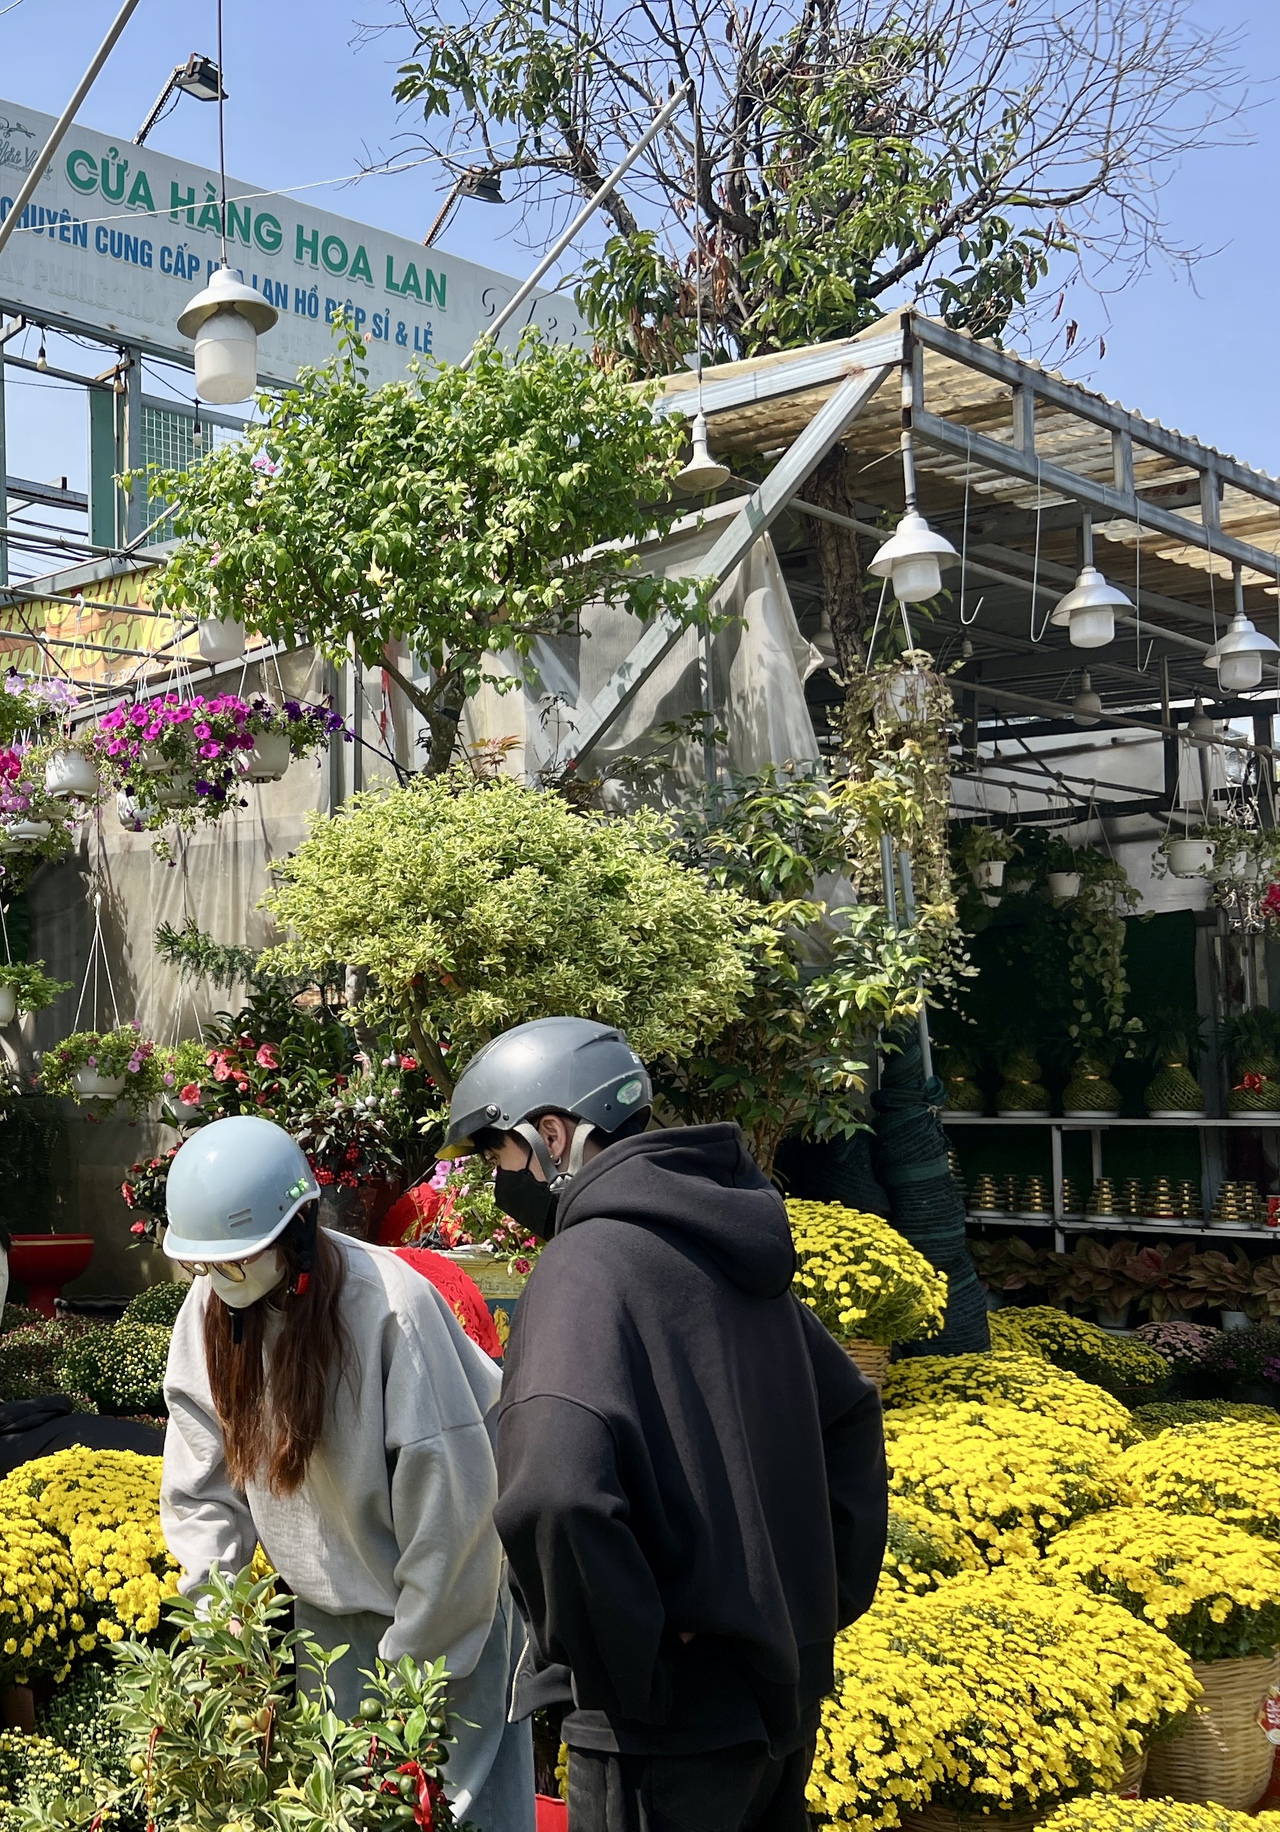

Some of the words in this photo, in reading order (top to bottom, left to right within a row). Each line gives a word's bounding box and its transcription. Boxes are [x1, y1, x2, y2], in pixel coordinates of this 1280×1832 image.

[0, 195, 88, 249] CHUYÊN
[95, 225, 153, 269] CUNG
[160, 242, 200, 281] CẤP
[294, 284, 319, 319] HỒ
[372, 308, 390, 341] SỈ
[395, 321, 408, 347] &
[414, 321, 433, 354] LẺ
[66, 146, 156, 212] CỬA
[170, 181, 283, 251] HÀNG
[296, 224, 373, 284] HOA
[386, 255, 447, 308] LAN
